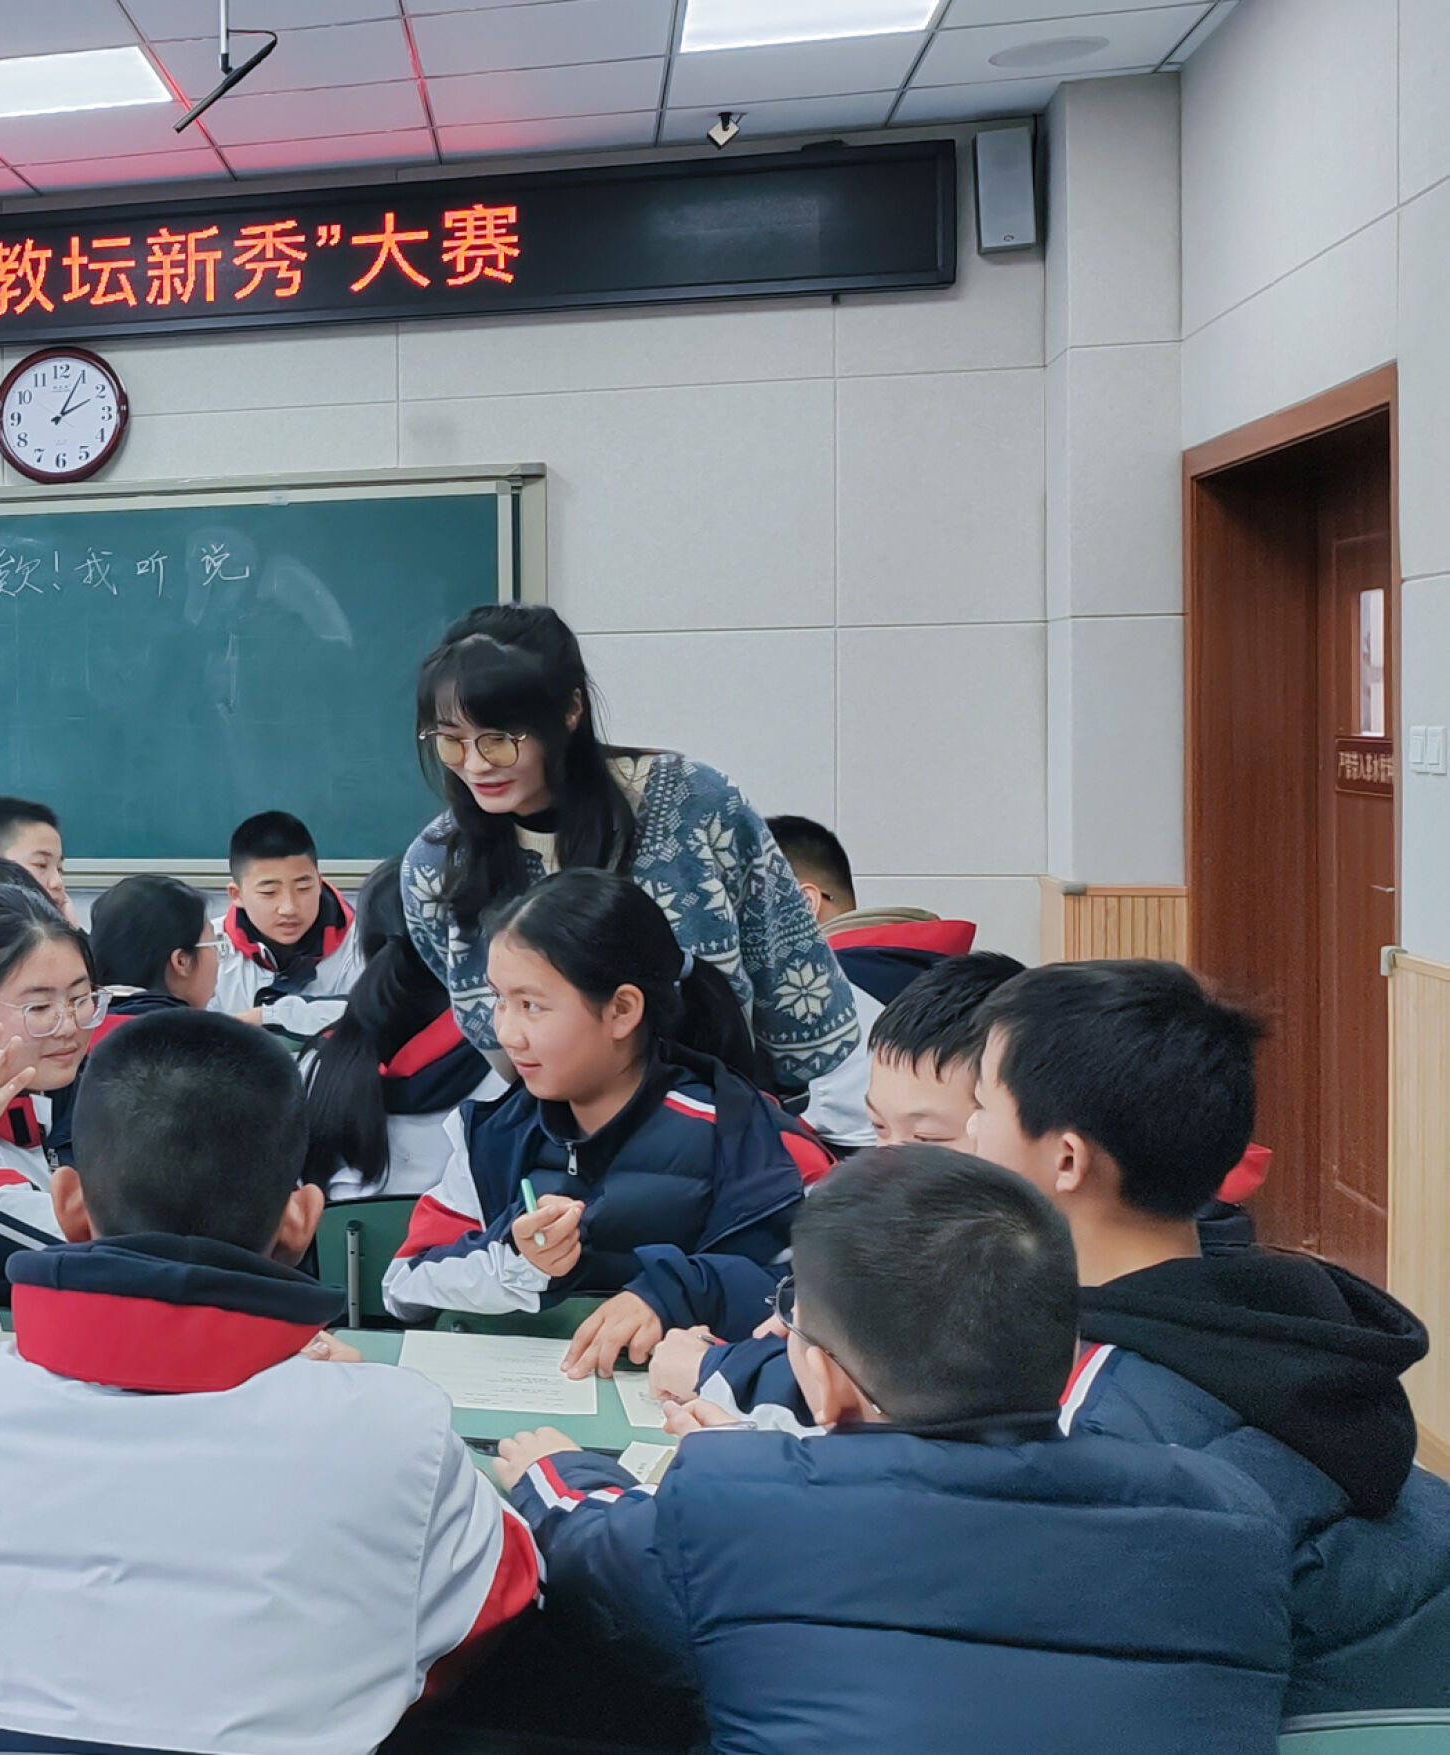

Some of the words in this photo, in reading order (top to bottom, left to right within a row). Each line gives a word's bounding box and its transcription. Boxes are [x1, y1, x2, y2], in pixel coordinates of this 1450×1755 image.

[53, 364, 71, 379] 12
[33, 373, 46, 387] 11
[18, 390, 32, 405] 10
[95, 384, 106, 399] 2
[10, 412, 22, 427] 9
[101, 406, 112, 421] 3
[17, 432, 28, 448] 8
[95, 427, 105, 443] 4
[34, 448, 45, 463] 7
[78, 446, 90, 460] 5
[55, 453, 67, 469] 6
